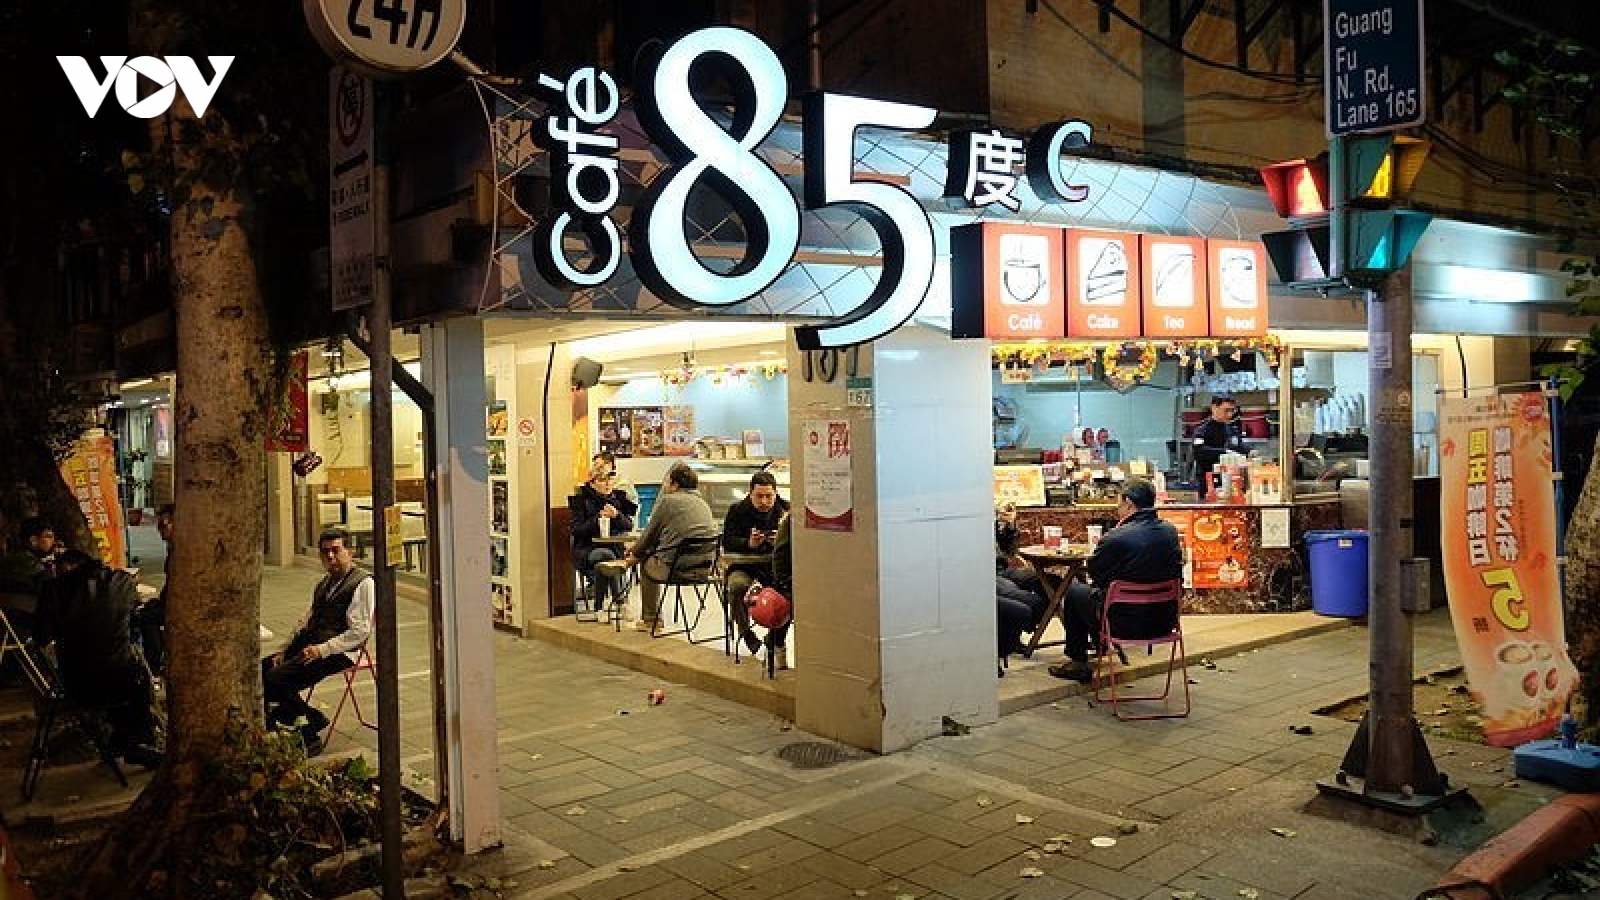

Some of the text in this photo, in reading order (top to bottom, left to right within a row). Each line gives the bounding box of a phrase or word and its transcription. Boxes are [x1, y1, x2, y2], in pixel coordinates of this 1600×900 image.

[1335, 7, 1393, 38] Guang
[1335, 46, 1357, 73] Fu
[1336, 65, 1395, 100] N. Rd.
[1336, 88, 1417, 128] Lane 165
[1007, 312, 1042, 330] Café
[1086, 313, 1119, 329] Cake
